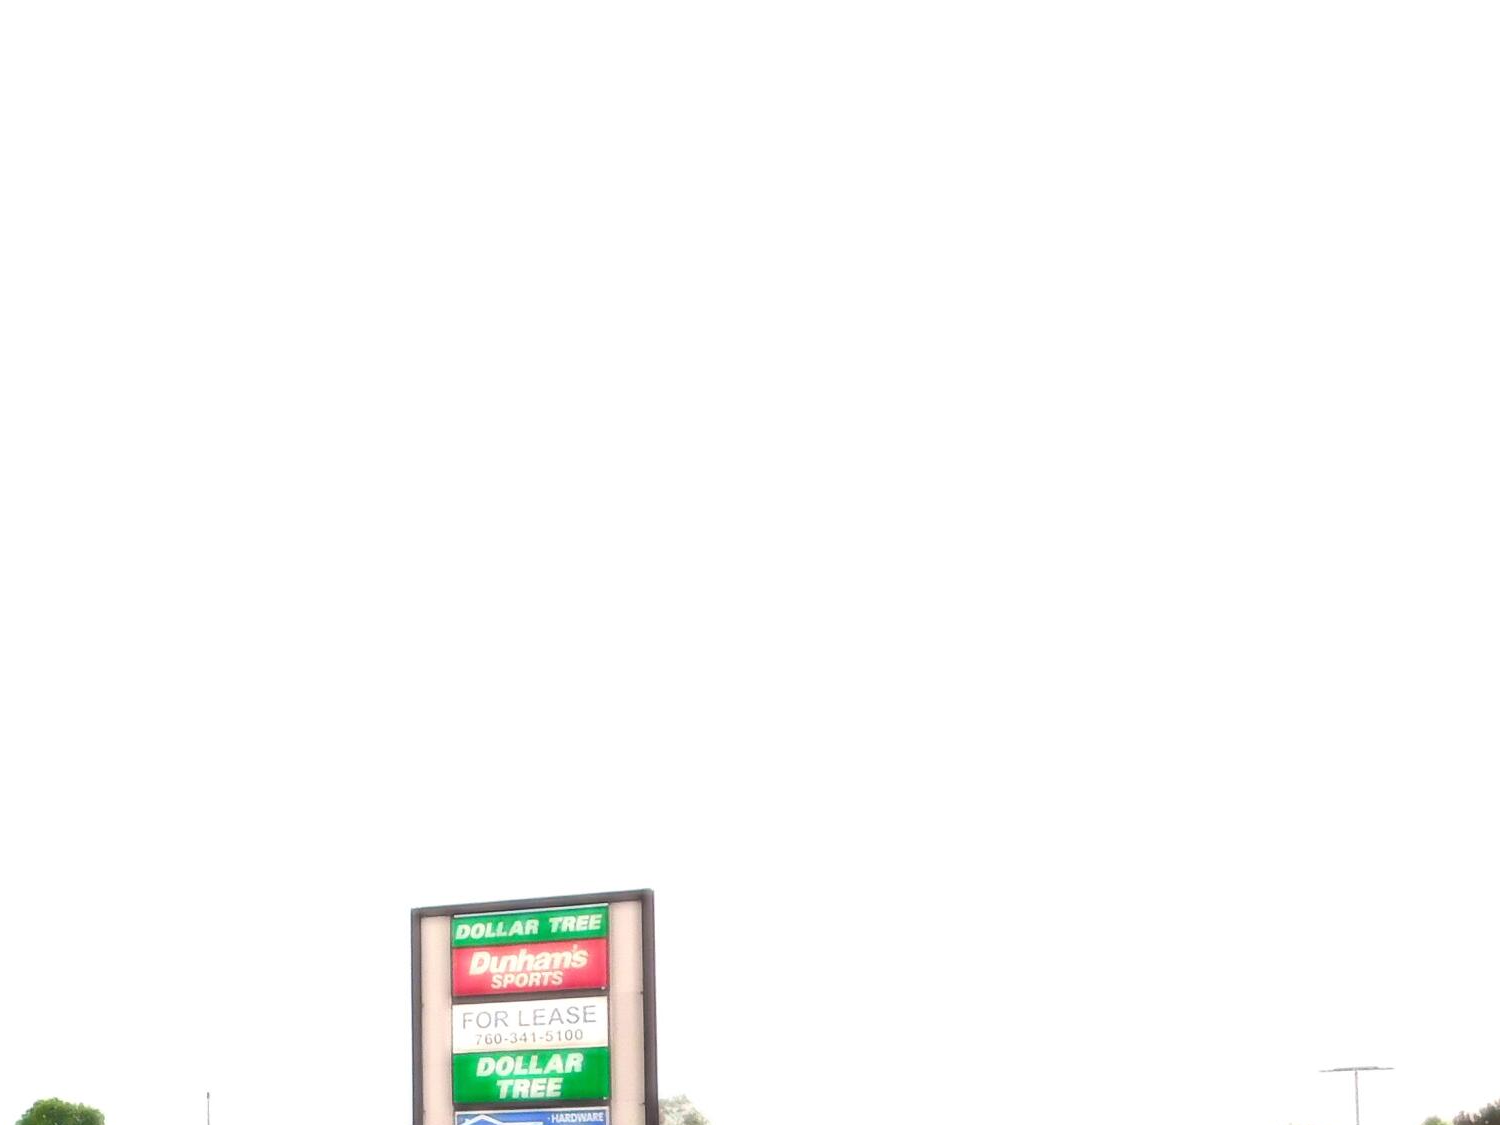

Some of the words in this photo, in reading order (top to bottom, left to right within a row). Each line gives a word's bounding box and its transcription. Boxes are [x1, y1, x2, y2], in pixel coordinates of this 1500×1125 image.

[455, 919, 539, 940] DOLLAR
[549, 914, 603, 933] TREE
[469, 944, 588, 976] Dunham's
[490, 971, 564, 989] SPORTS
[462, 1010, 510, 1030] FOR
[518, 1005, 597, 1027] LEASE
[475, 1029, 584, 1046] 760-341-5100
[476, 1053, 584, 1077] DOLLAR
[496, 1077, 564, 1099] TREE
[551, 1112, 604, 1123] HARDWARE
